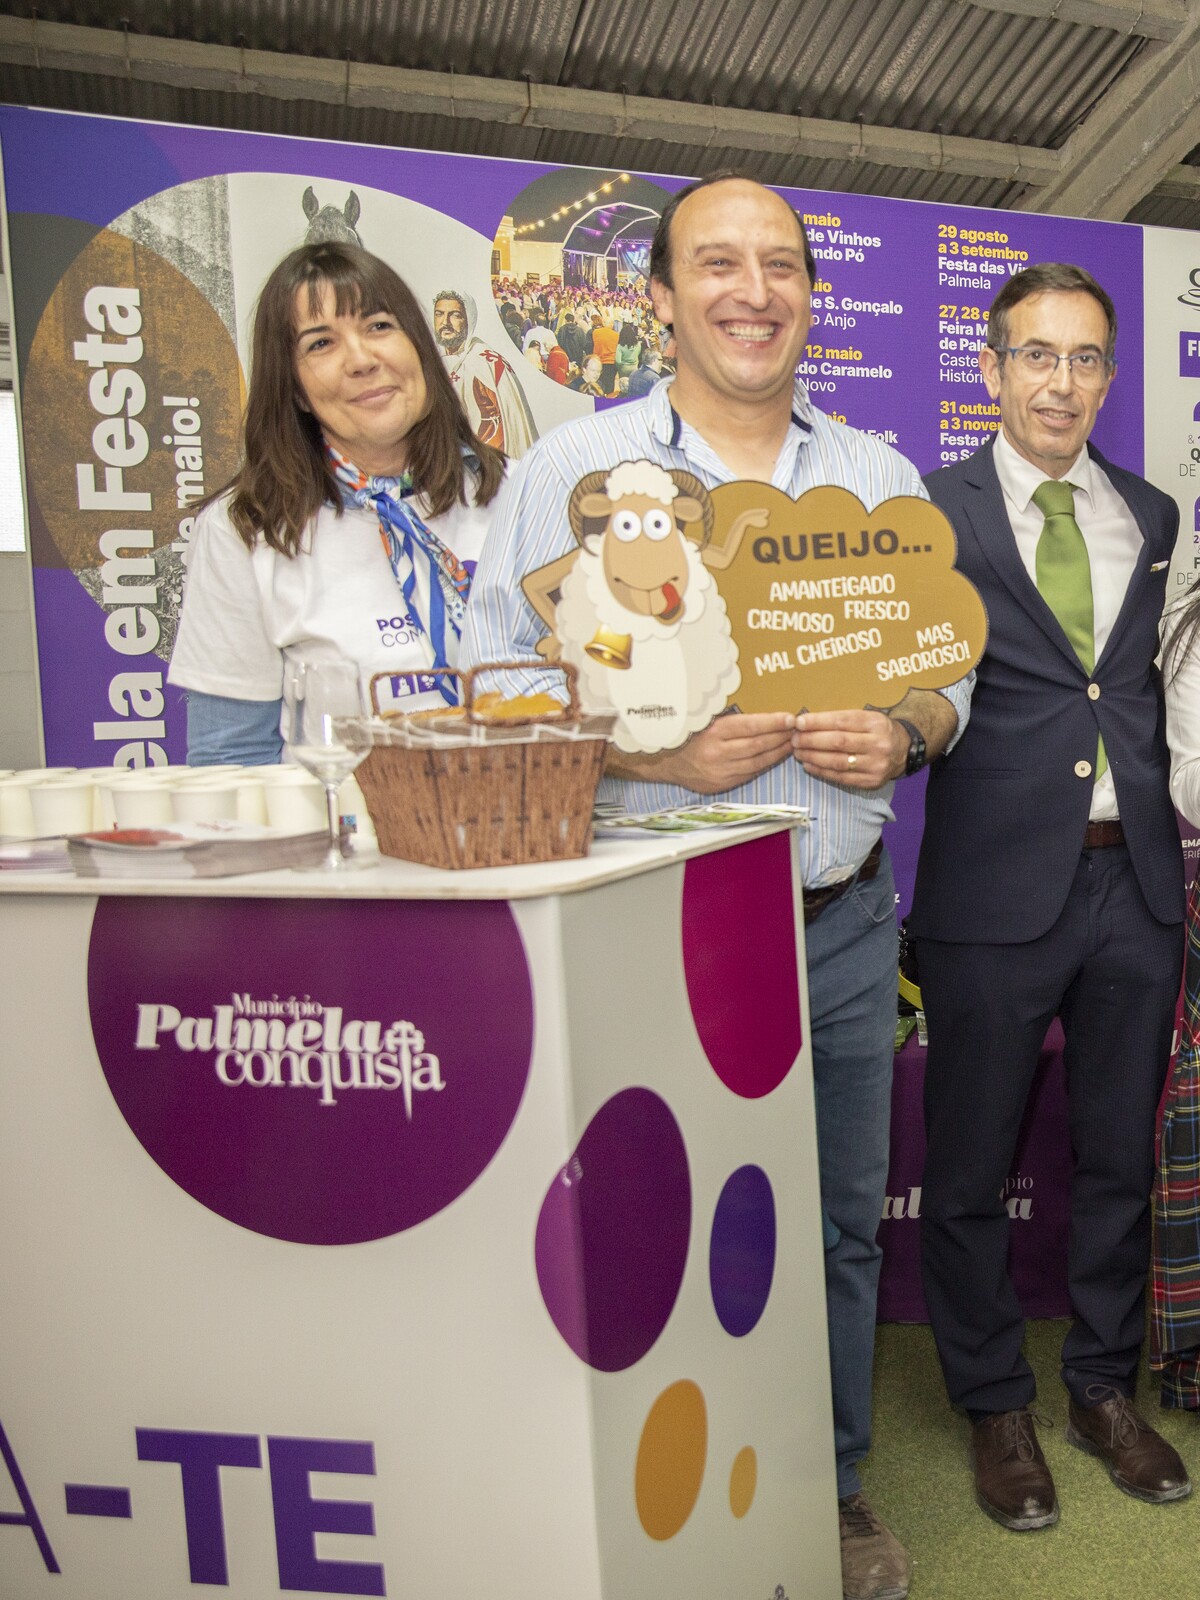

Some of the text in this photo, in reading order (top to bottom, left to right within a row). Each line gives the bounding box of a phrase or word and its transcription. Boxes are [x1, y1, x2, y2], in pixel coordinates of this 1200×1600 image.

[803, 212, 841, 228] maio
[827, 229, 882, 248] Vinhos
[938, 224, 1009, 244] 29 agosto
[810, 246, 865, 263] ndo Pó
[938, 241, 1029, 261] a 3 setembro
[938, 256, 977, 273] Festa
[979, 260, 1005, 275] das
[939, 272, 991, 290] Palmela
[824, 296, 839, 310] S.
[841, 297, 903, 317] Gonçalo
[939, 304, 959, 322] 27,
[961, 306, 980, 321] 28
[824, 312, 856, 331] Anjo
[939, 320, 974, 336] Feira
[805, 344, 863, 361] 12 maio
[939, 337, 957, 350] de
[939, 353, 979, 368] Caste
[820, 362, 893, 379] Caramelo
[940, 368, 985, 384] Históri
[798, 377, 837, 392] Novo
[75, 286, 152, 512] Festa
[940, 400, 1001, 416] 31 outub
[940, 419, 949, 430] a
[951, 417, 961, 431] 3
[940, 432, 979, 447] Festa
[163, 395, 205, 509] maio!
[940, 451, 958, 462] os
[1179, 464, 1196, 477] DE
[752, 529, 933, 564] QUEIJO...
[98, 530, 160, 656] em
[843, 600, 910, 621] FRESCO
[747, 608, 835, 634] CREMOSO
[916, 621, 955, 649] MAS
[754, 651, 794, 677] MAL
[876, 640, 971, 682] SABOROSO!
[231, 992, 324, 1020] Município
[134, 1003, 386, 1052] Palmela
